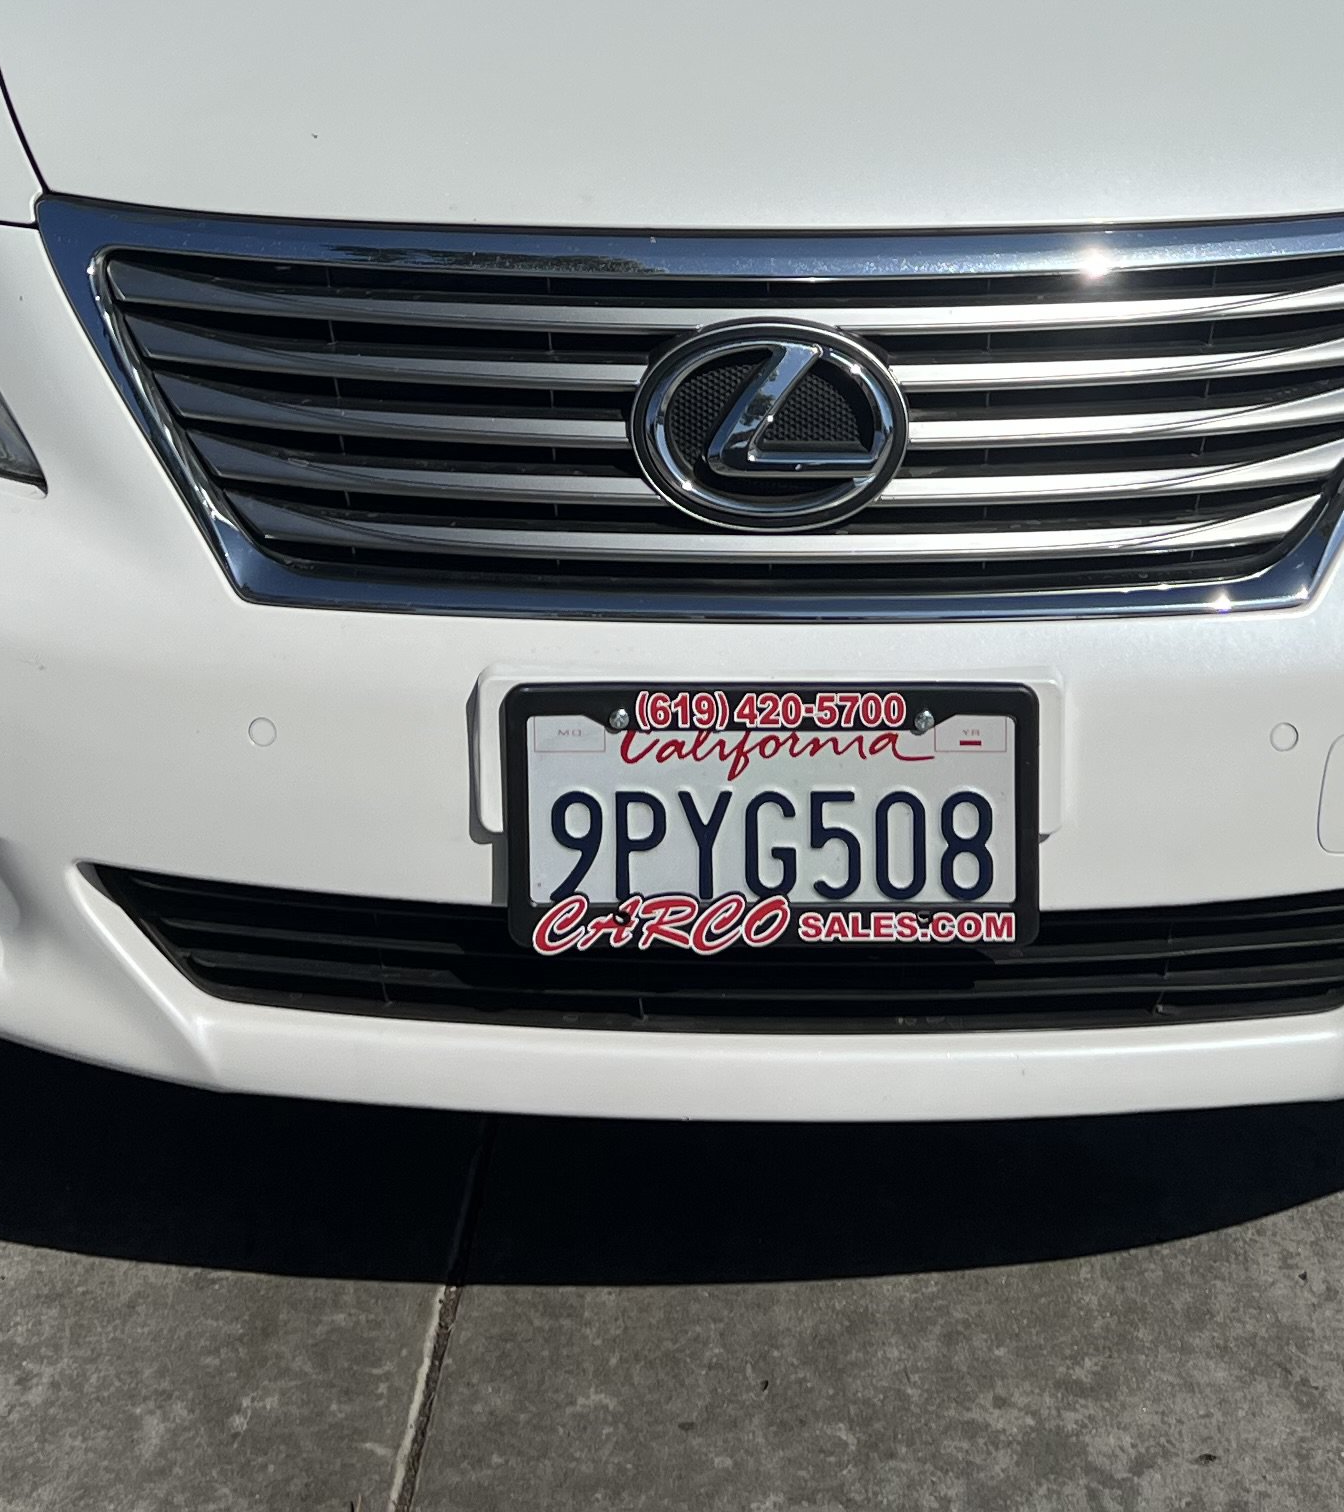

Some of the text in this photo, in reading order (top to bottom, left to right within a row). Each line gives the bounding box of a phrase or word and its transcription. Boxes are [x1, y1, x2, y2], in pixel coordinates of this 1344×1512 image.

[635, 691, 907, 730] (619) 420-5700
[619, 729, 936, 781] California
[549, 789, 994, 901] 9PYG508
[533, 892, 1016, 955] CARCO SALES.COM
